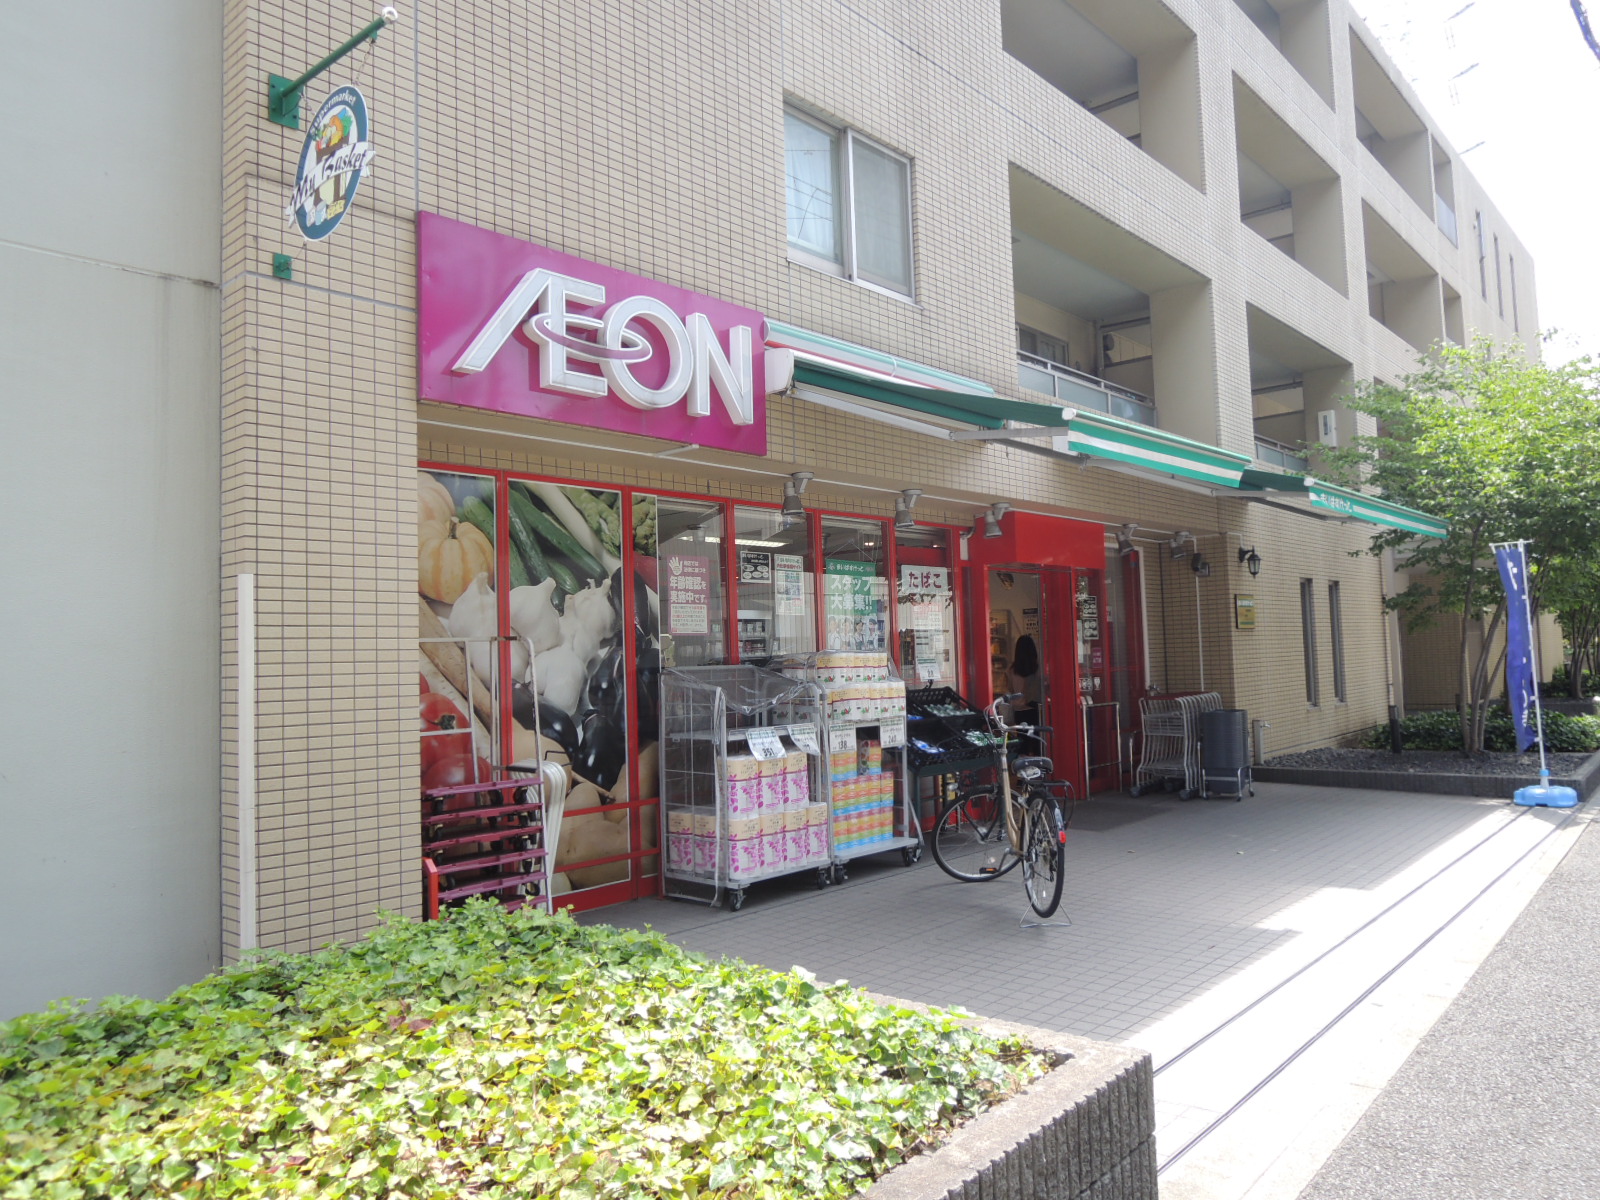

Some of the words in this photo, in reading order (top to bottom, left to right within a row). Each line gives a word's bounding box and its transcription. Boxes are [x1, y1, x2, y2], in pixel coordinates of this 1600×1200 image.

[322, 143, 366, 181] Basket
[451, 267, 754, 425] AEON
[669, 575, 707, 590] 年齢確認を
[830, 574, 871, 592] スタッフ
[908, 571, 942, 589] たばこ
